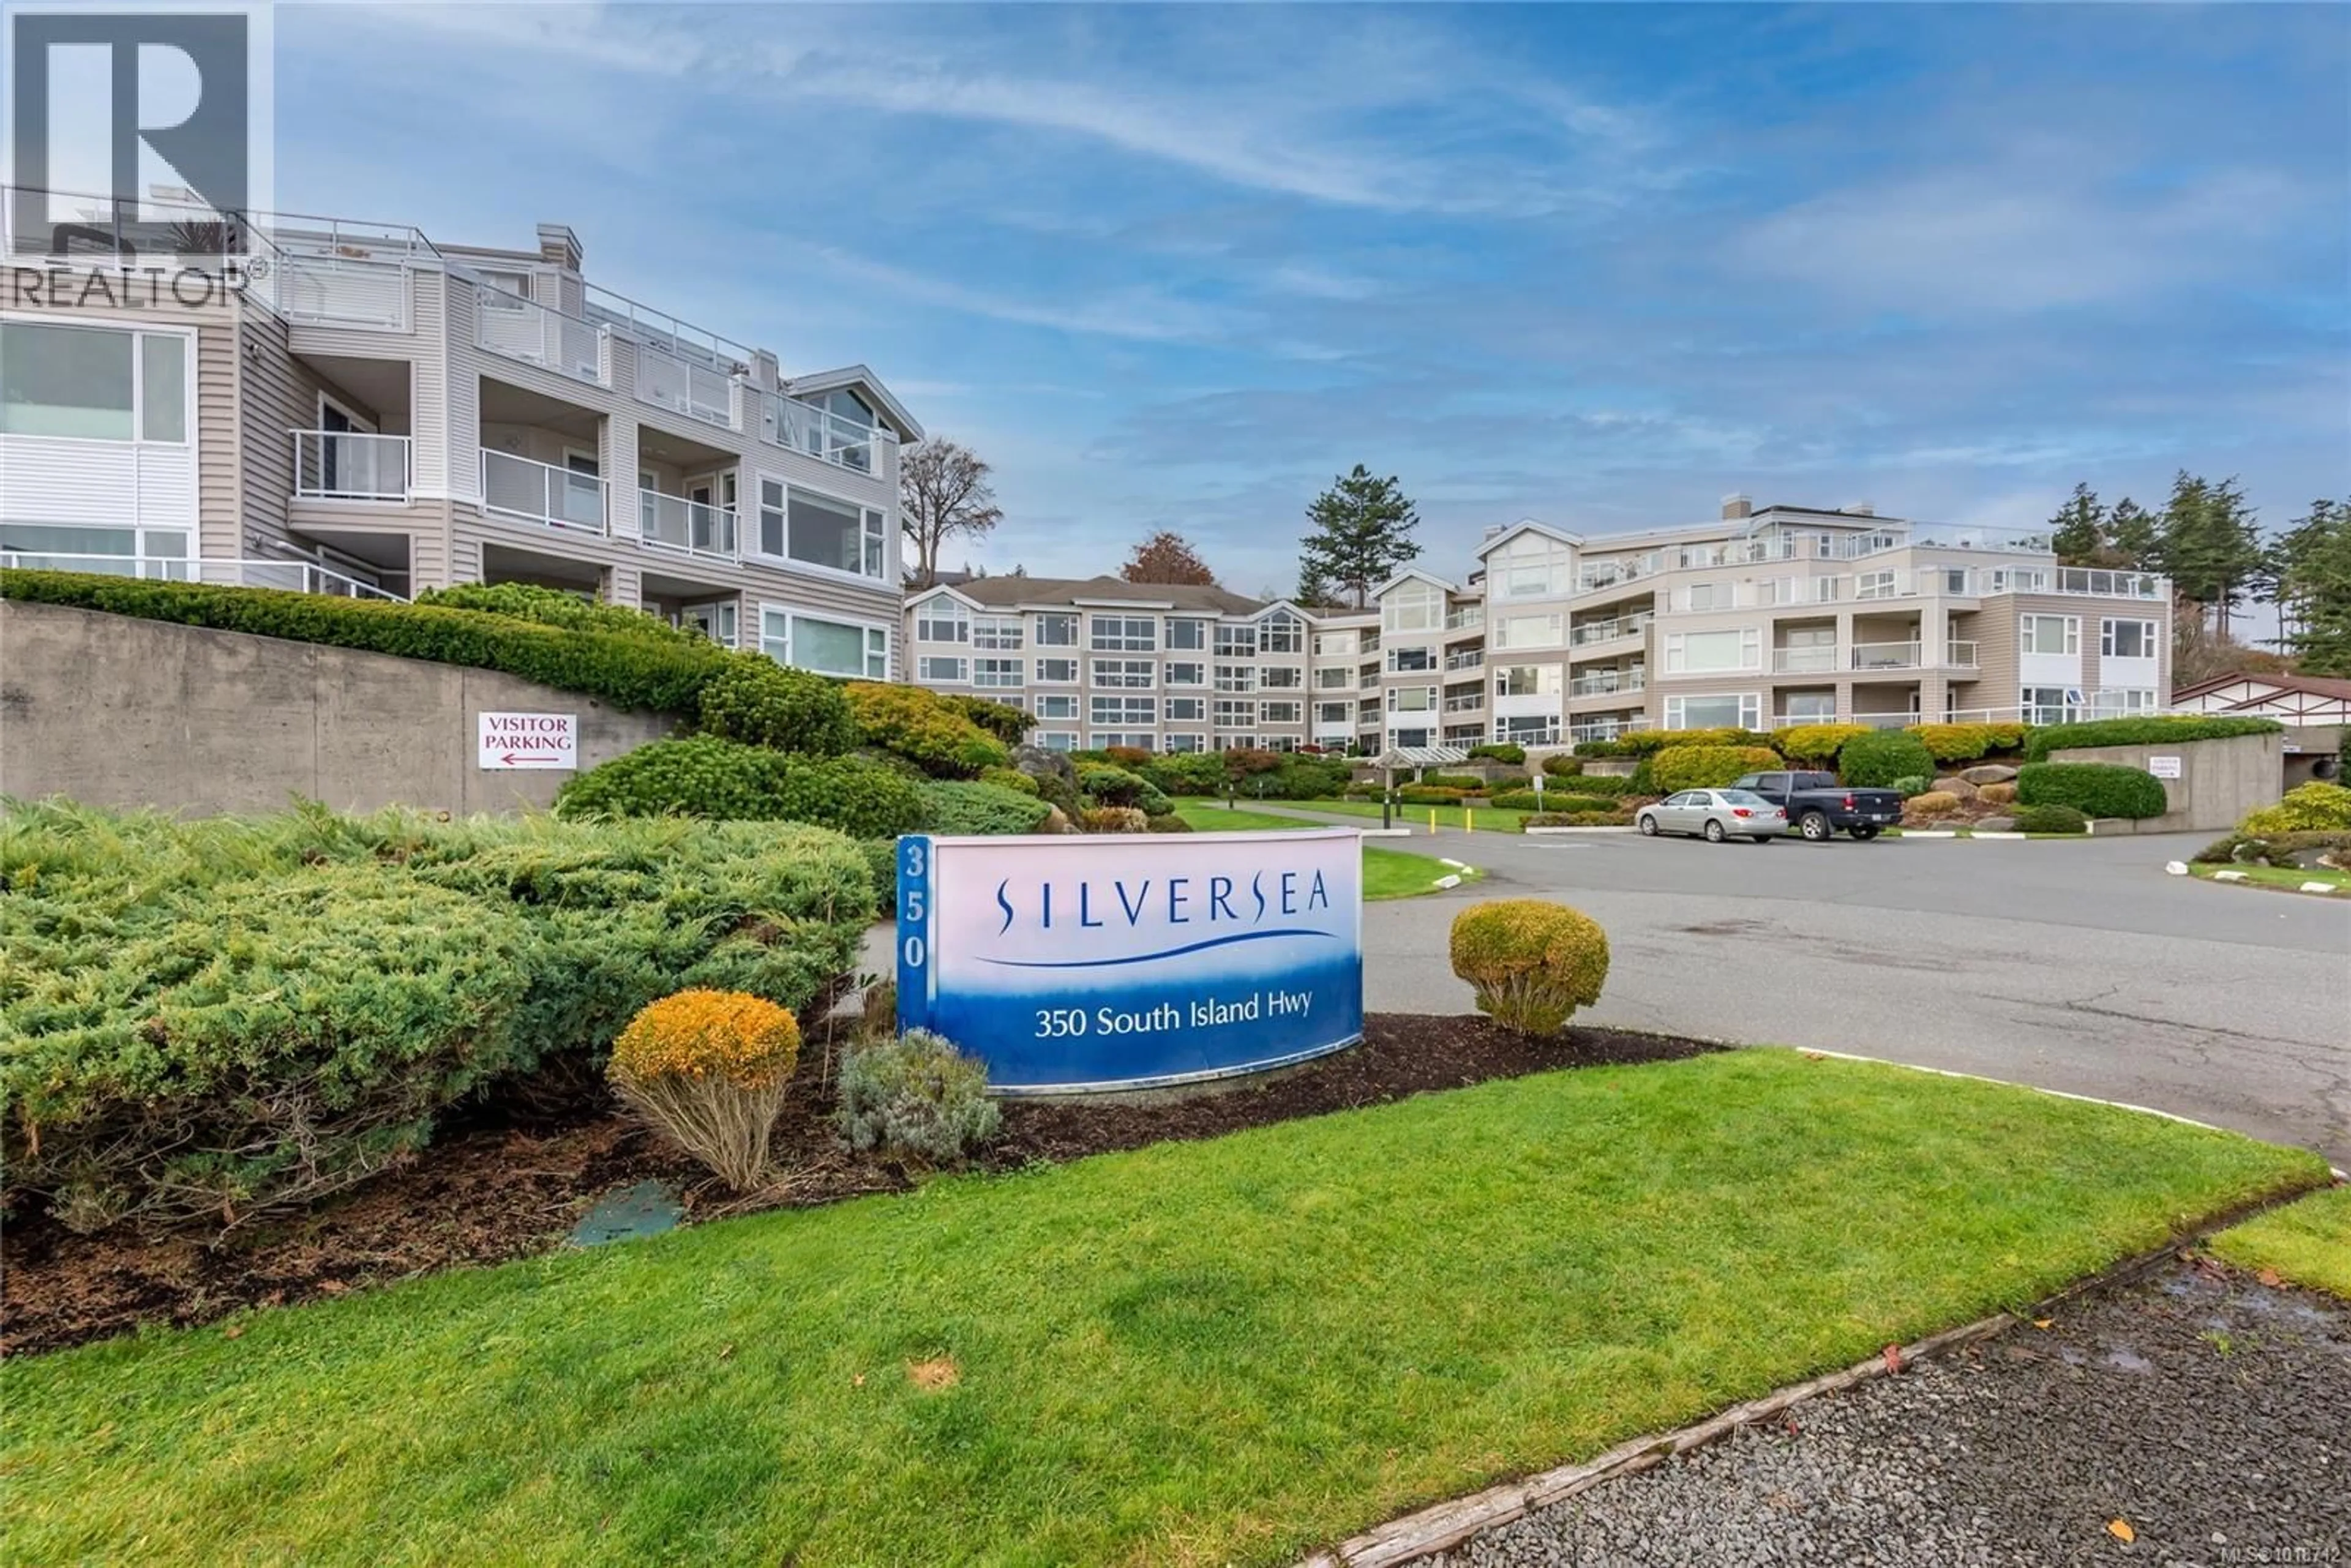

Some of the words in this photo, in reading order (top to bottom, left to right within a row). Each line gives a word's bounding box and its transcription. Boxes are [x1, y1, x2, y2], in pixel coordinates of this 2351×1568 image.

[486, 735, 571, 750] PARKING
[489, 717, 568, 732] VISITOR
[905, 844, 925, 967] 350
[996, 867, 1330, 937] SILVERSEA
[1035, 1008, 1086, 1038] 350
[1097, 1002, 1180, 1035] South
[1191, 988, 1259, 1027] Island
[1268, 989, 1313, 1019] Hwy
